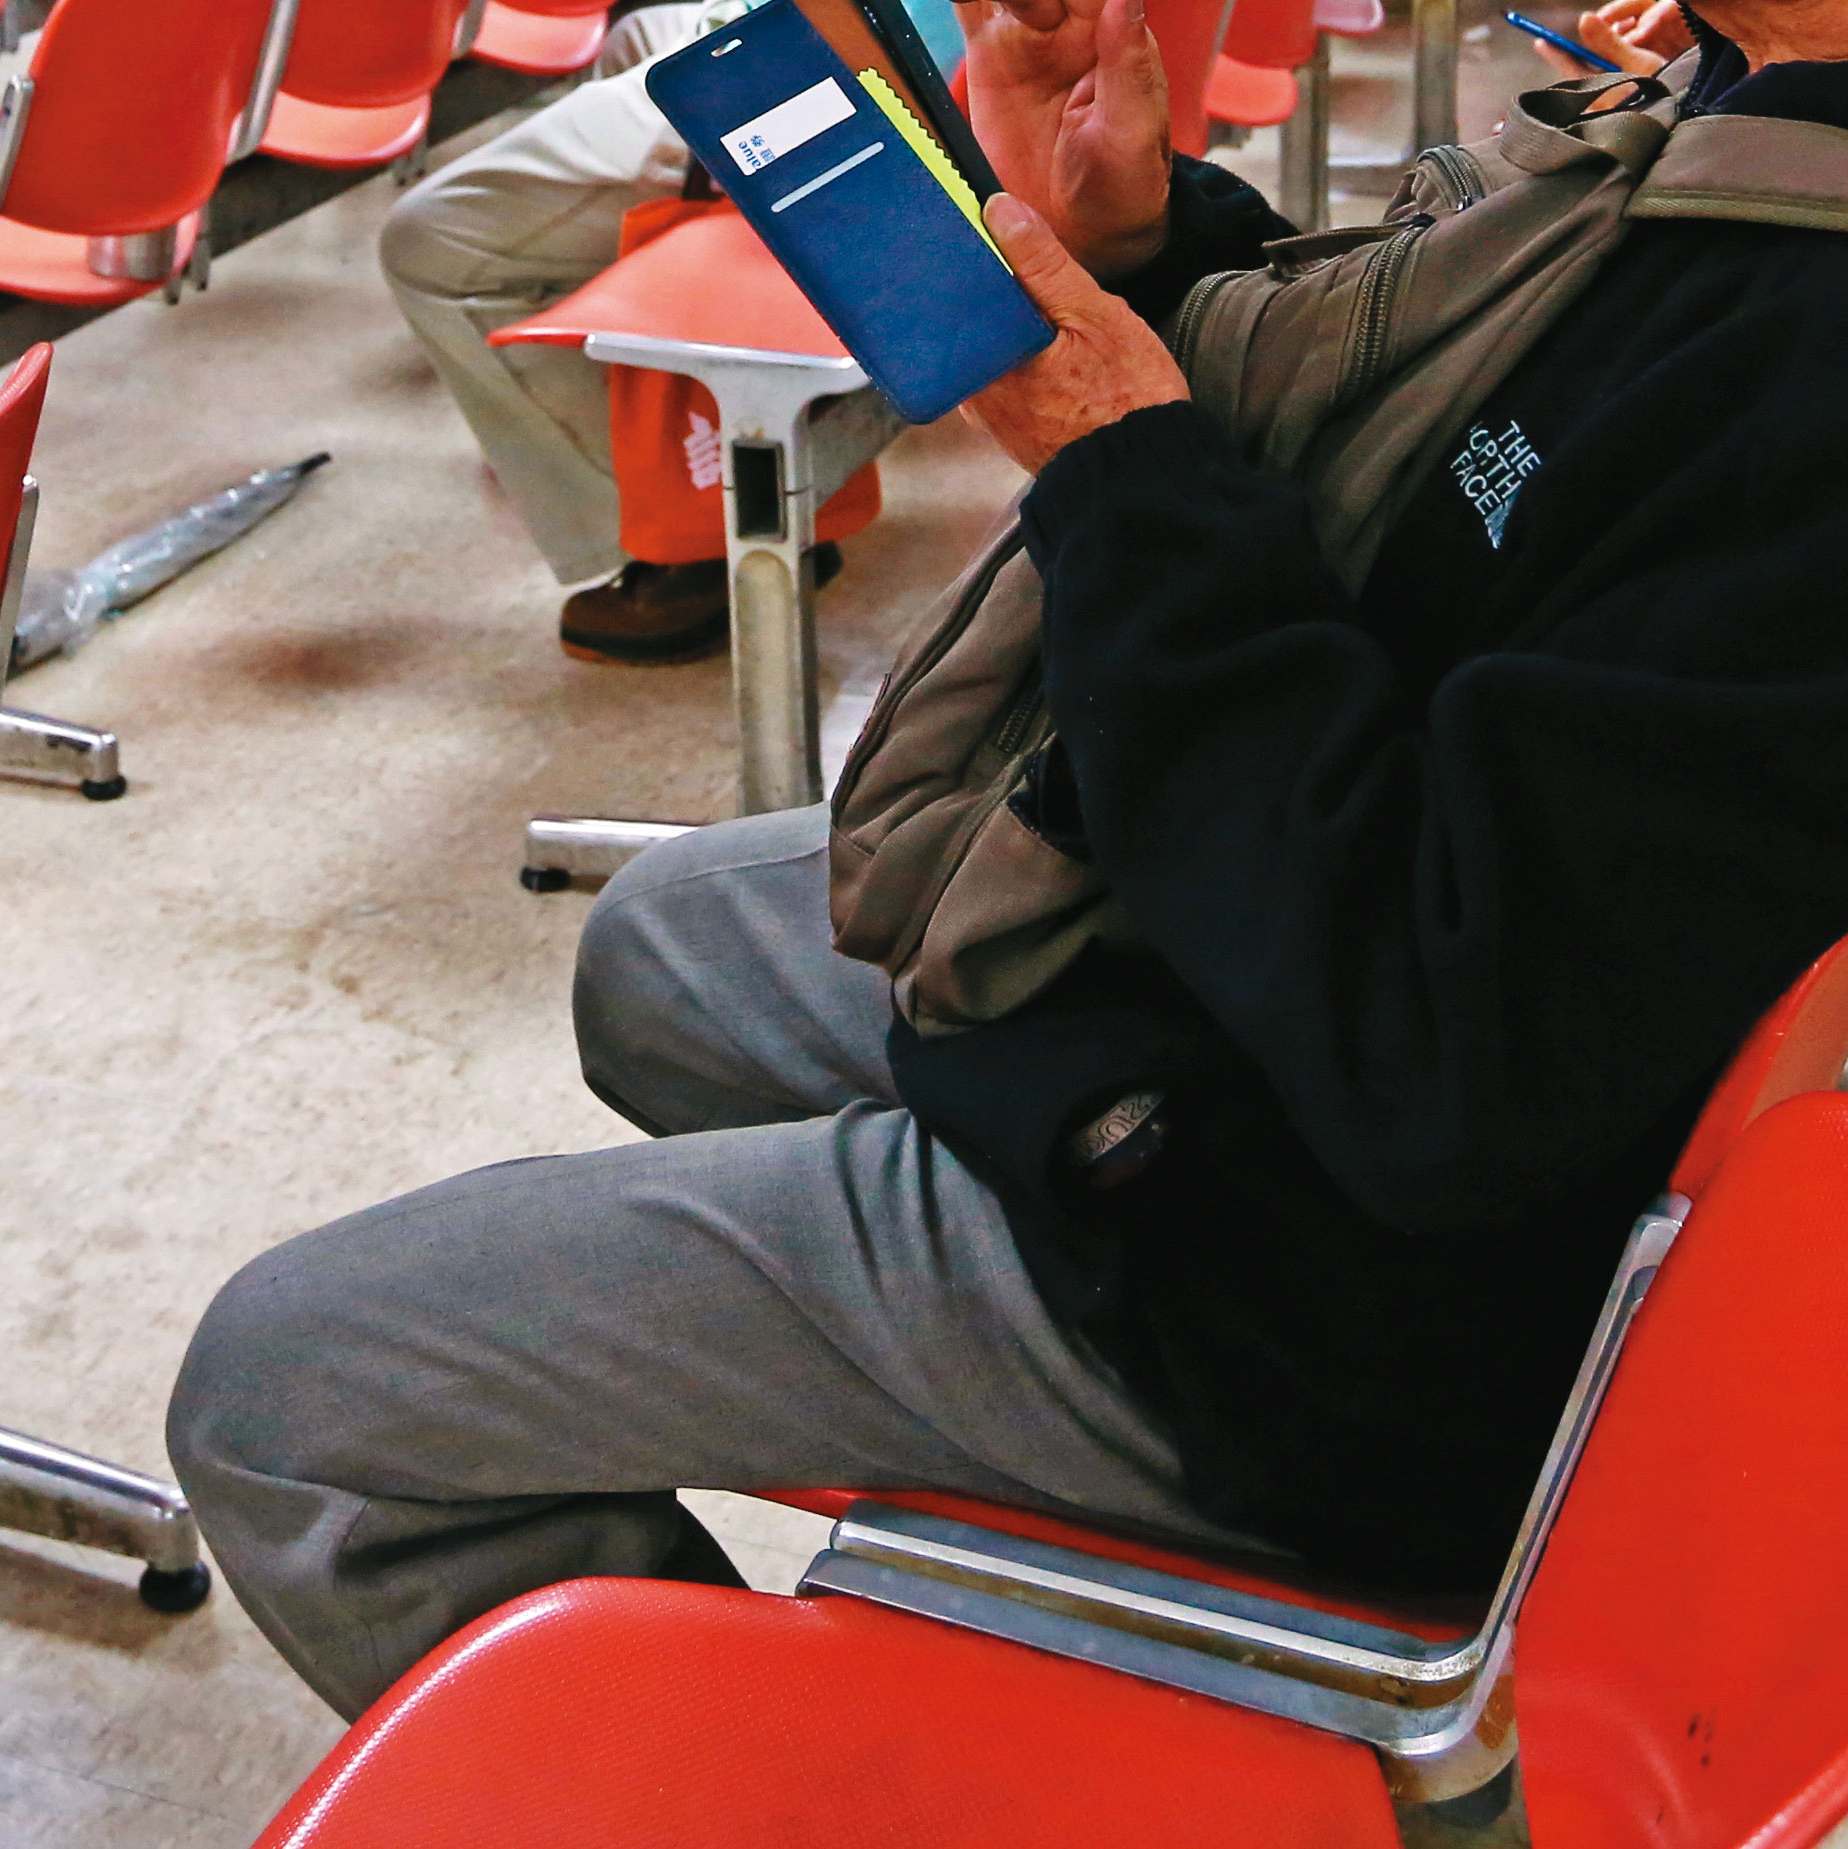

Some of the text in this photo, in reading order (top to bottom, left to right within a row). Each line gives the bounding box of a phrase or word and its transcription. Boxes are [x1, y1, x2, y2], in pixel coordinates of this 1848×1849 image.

[1469, 421, 1522, 499] ORTH
[1498, 419, 1542, 478] THE
[1449, 449, 1501, 516] FACE
